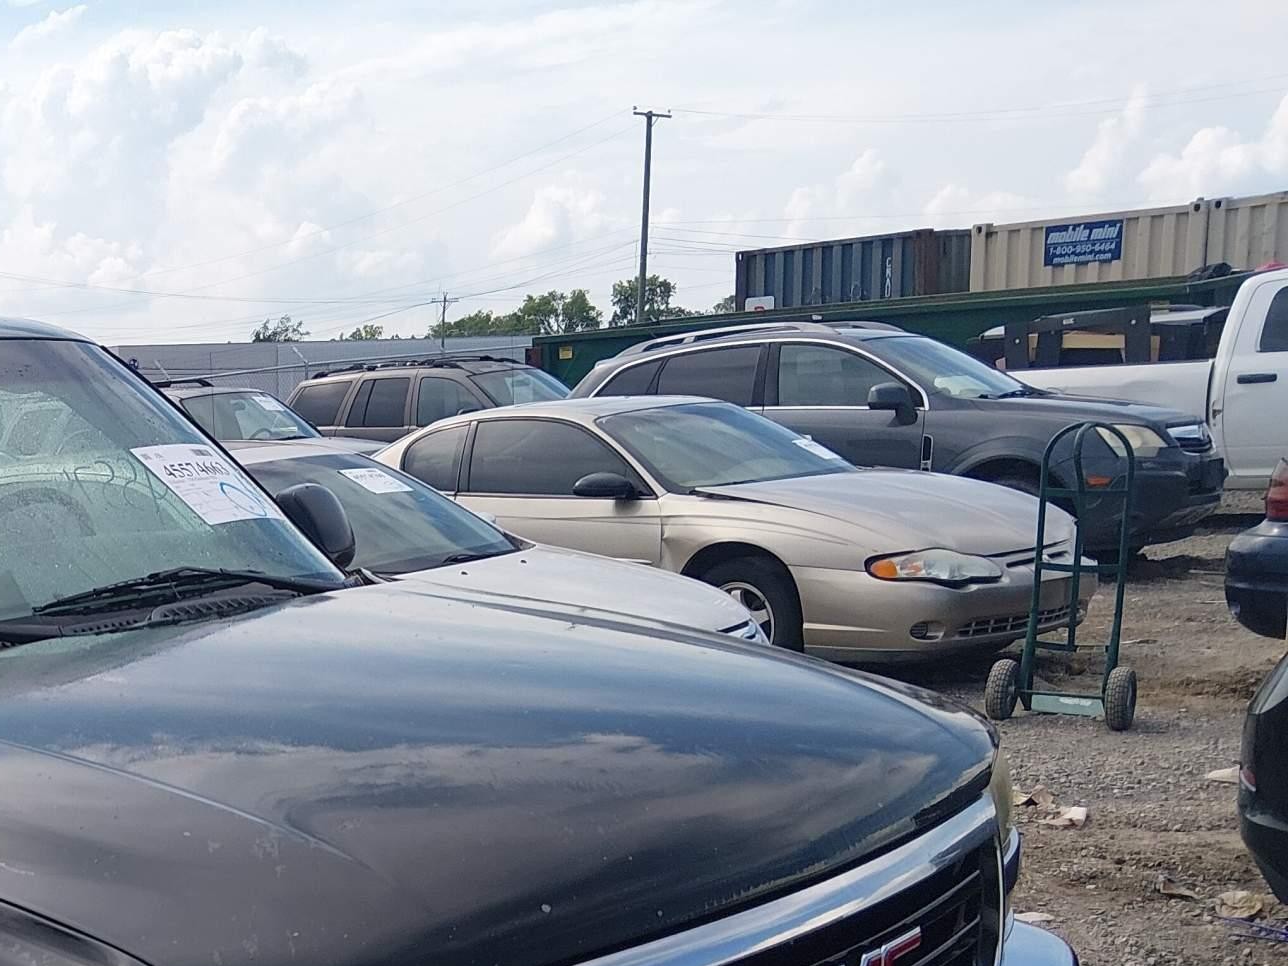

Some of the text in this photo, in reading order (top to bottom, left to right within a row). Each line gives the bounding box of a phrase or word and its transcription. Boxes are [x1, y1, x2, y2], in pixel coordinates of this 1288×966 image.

[1047, 223, 1121, 244] mobile mini
[163, 460, 230, 479] 45574663
